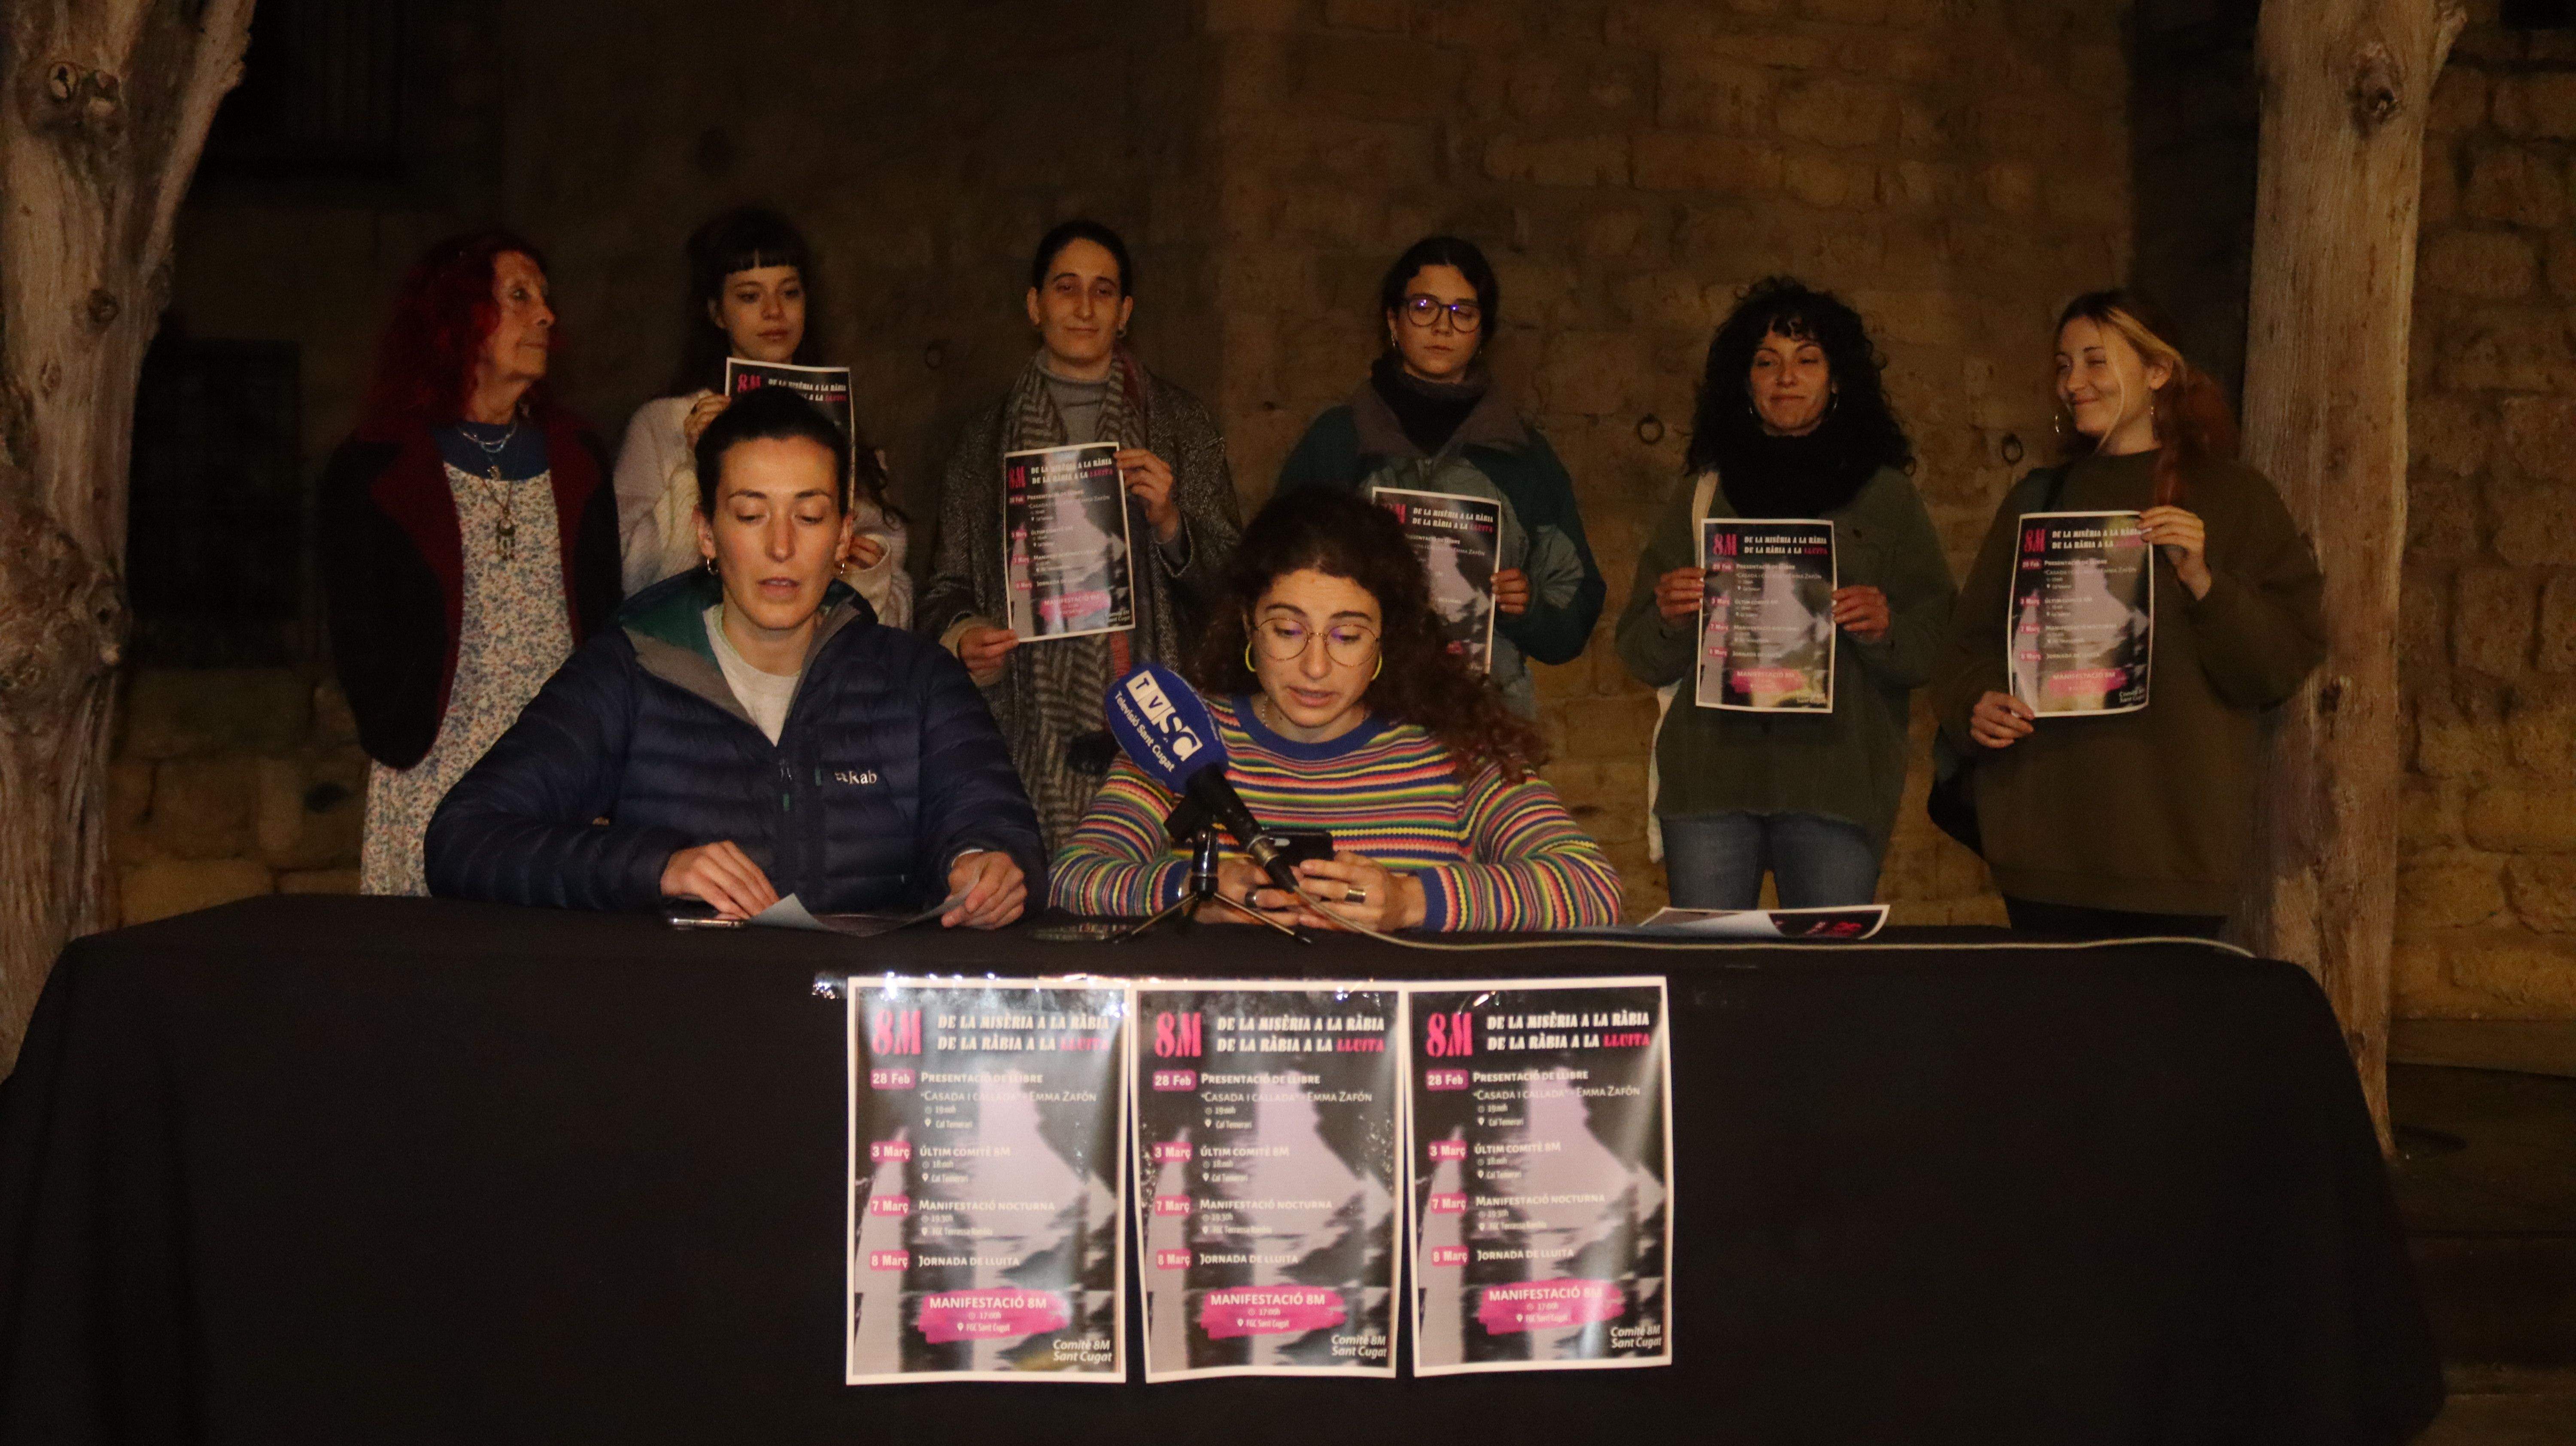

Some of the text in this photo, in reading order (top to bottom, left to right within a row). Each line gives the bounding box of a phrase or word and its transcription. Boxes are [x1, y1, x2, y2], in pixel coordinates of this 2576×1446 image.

[1137, 724, 1154, 747] Sant
[1152, 744, 1175, 772] Cugat
[938, 1012, 1109, 1029] DE LA MISÈRIA A LA RÀBIA
[1217, 1014, 1385, 1030] DE LA MISÈRIA A LA RÀBIA
[1486, 1009, 1649, 1030] DE LA MISÈRIA A LA RÀBIA
[872, 1009, 921, 1055] 8M
[1154, 1012, 1201, 1058] 8M
[1426, 1012, 1473, 1057] 8M
[938, 1036, 957, 1050] DE
[961, 1036, 976, 1050] LA
[981, 1033, 1022, 1050] RÀBIA
[1026, 1036, 1035, 1050] A
[1039, 1037, 1055, 1051] LA
[1217, 1038, 1236, 1052] DE
[1239, 1038, 1256, 1052] LA
[1260, 1035, 1300, 1052] RÀBIA
[1303, 1038, 1312, 1052] A
[1316, 1038, 1332, 1052] LA
[1486, 1036, 1505, 1051] DE
[1509, 1036, 1525, 1050] LA
[1528, 1032, 1567, 1050] RÀBIA
[1571, 1034, 1580, 1048] A
[1583, 1034, 1600, 1048] LA
[873, 1073, 910, 1084] 28 Feb
[1155, 1075, 1191, 1086] 28 Feb
[1201, 1072, 1271, 1084] PRESENTACIÓ
[1273, 1075, 1285, 1084] DE
[1428, 1074, 1464, 1086] 28 Feb
[1473, 1070, 1539, 1083] PRESENTACIÓ
[1542, 1072, 1554, 1081] DE
[1031, 1091, 1060, 1102] EMMA
[1062, 1090, 1097, 1102] ZAFÓN
[1308, 1093, 1337, 1102] EMMA
[1339, 1091, 1373, 1102] ZAFÓN
[1577, 1087, 1606, 1097] EMMA
[1607, 1085, 1640, 1097] ZAFÓN
[872, 1146, 910, 1159] 3 Març
[920, 1145, 951, 1157] ÚLTIM
[953, 1145, 990, 1157] COMITÈ
[1154, 1147, 1191, 1159] 3 Març
[1200, 1145, 1230, 1157] ÚLTIM
[1233, 1145, 1270, 1157] COMITÈ
[1430, 1145, 1466, 1158] 3 Març
[1474, 1143, 1504, 1154] ÚLTIM
[1507, 1142, 1543, 1153] COMITÈ
[919, 1200, 995, 1211] MANIFESTACIÓ
[1200, 1199, 1332, 1209] MANIFESTACIÓ NOCTURNA
[1433, 1198, 1466, 1211] 7 Març
[1476, 1194, 1605, 1206] MANIFESTACIÓ NOCTURNA
[872, 1200, 909, 1213] 7 Març
[1157, 1201, 1190, 1213] 7 Març
[1158, 1254, 1190, 1267] 8 Març
[1200, 1254, 1298, 1264] JORNADA DE LLUITA
[1433, 1251, 1467, 1263] 8 Març
[1477, 1249, 1574, 1261] JORNADA DE LLUITA
[872, 1255, 907, 1268] 8 Març
[919, 1256, 1019, 1267] JORNADA DE LLUITA
[1211, 1292, 1325, 1305] MANIFESTACIÓ 8M
[1489, 1286, 1580, 1301] MANIFESTACIÓ
[929, 1296, 1046, 1309] MANIFESTACIÓ 8M
[1646, 1324, 1660, 1335] 8M
[1053, 1339, 1110, 1351] Comitè 8M
[1332, 1334, 1385, 1346] Comitè 8M
[1611, 1337, 1661, 1349] Sant Cugat
[1053, 1351, 1112, 1364] Sant Cugat
[1332, 1346, 1387, 1359] Sant Cugat
